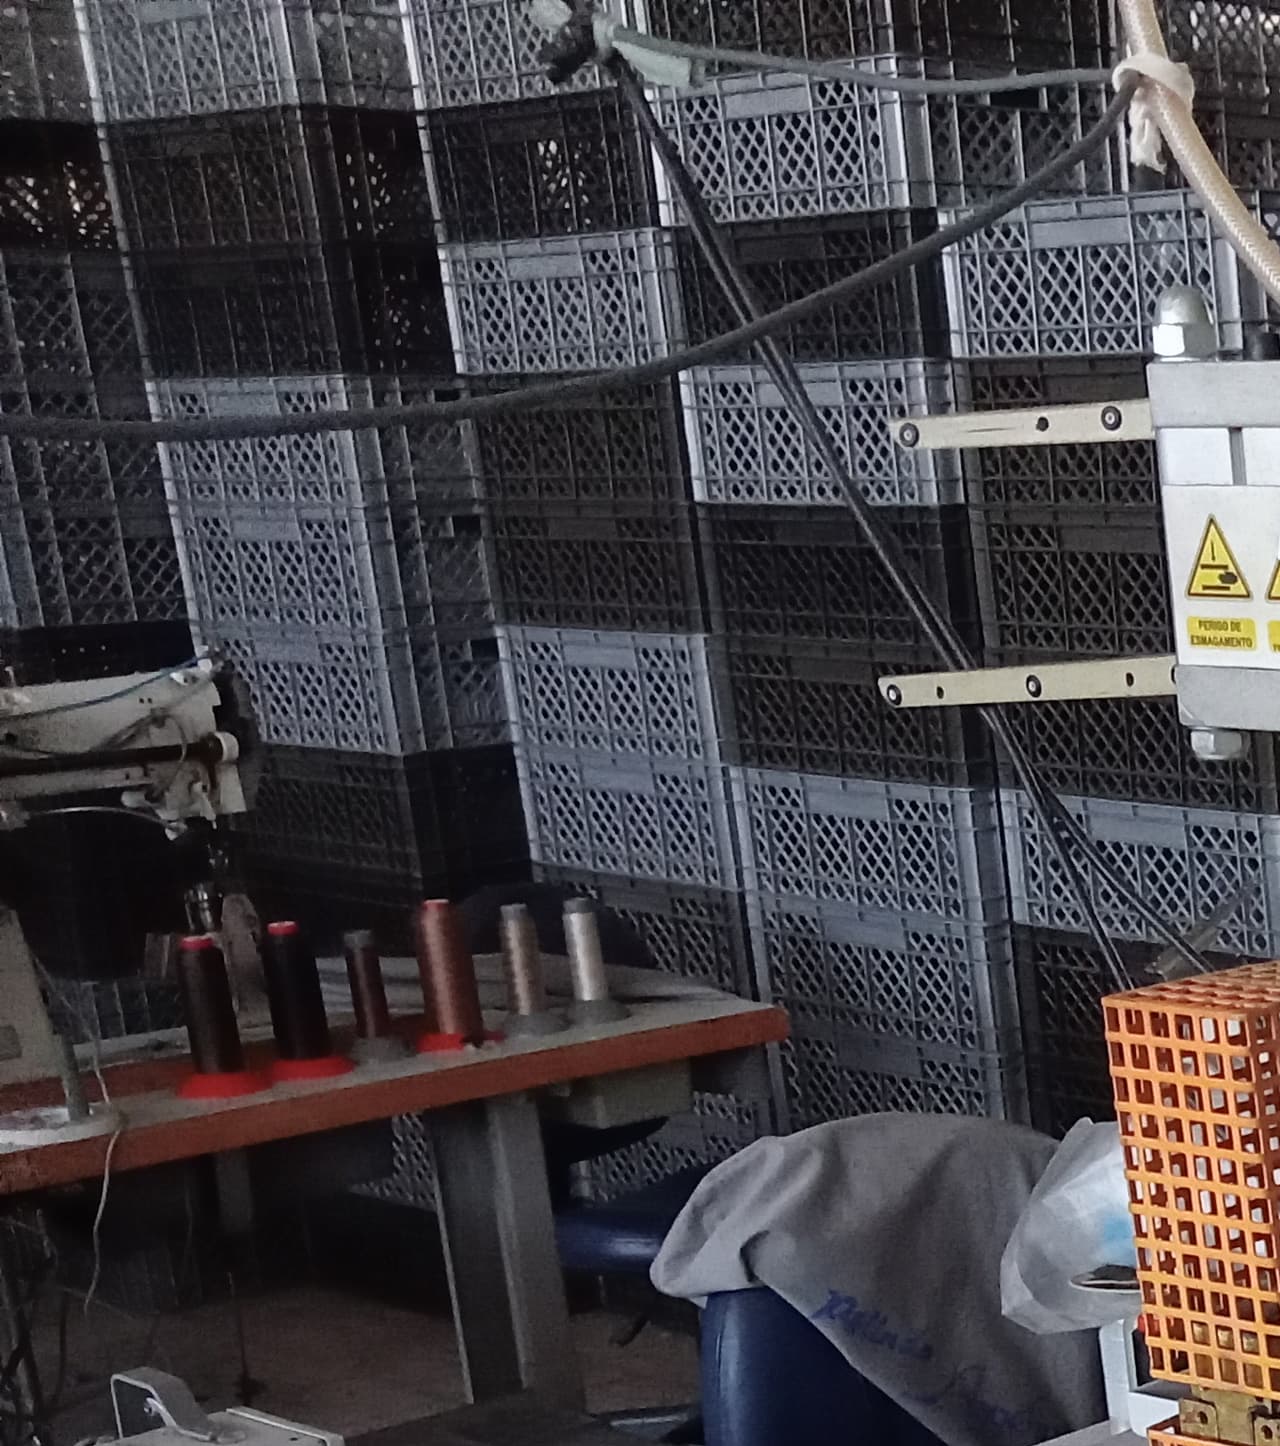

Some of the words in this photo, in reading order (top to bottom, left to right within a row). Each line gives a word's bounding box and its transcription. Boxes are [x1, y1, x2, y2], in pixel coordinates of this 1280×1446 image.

[1198, 619, 1228, 632] PERIGO
[1229, 621, 1242, 633] DE
[1190, 634, 1253, 648] ESMAGAMENTO
